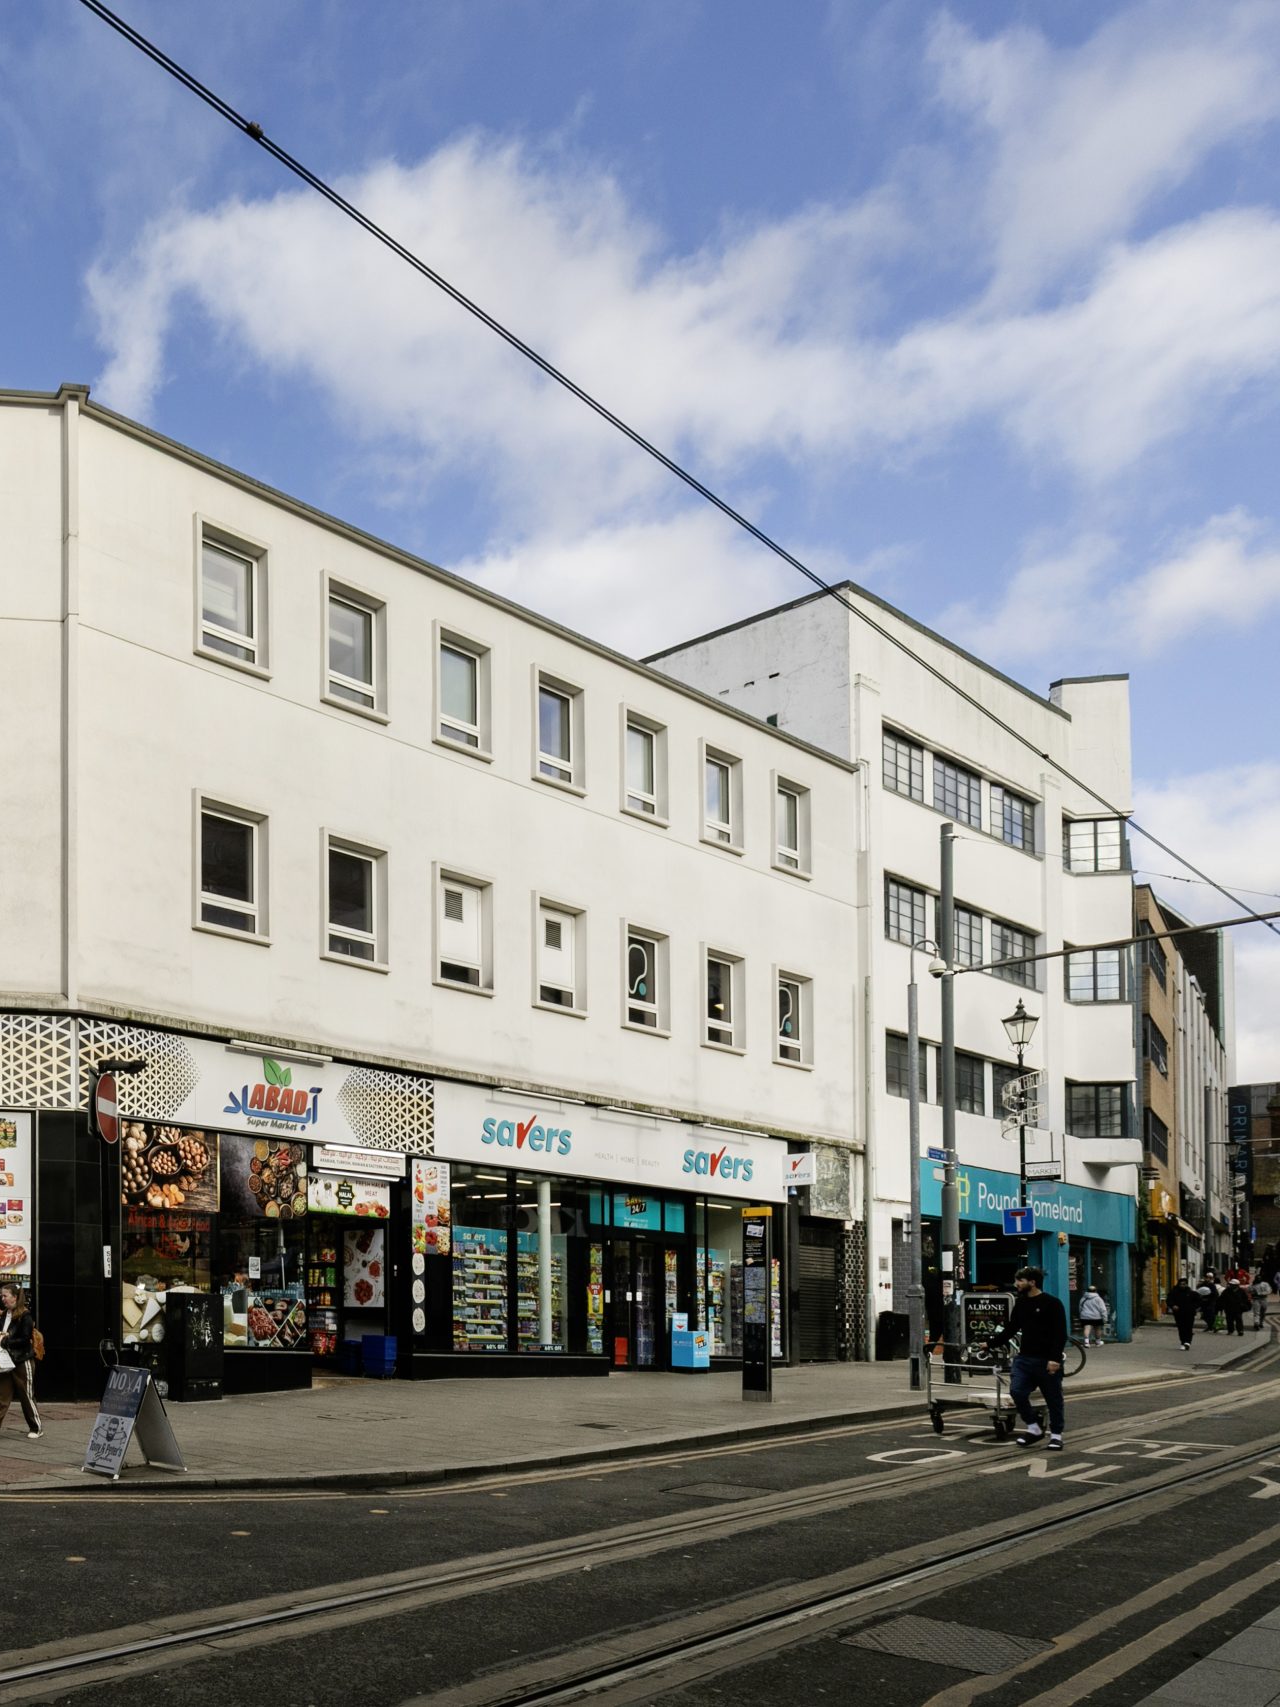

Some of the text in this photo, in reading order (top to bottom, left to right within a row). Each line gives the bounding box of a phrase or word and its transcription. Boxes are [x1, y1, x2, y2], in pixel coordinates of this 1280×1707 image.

[248, 1083, 308, 1115] ABAD
[247, 1116, 298, 1131] Super Market
[481, 1115, 573, 1155] savers
[1232, 1105, 1248, 1175] PRIMAR
[594, 1152, 660, 1167] HEALTH HOME BEAUTY
[682, 1146, 754, 1182] savers
[978, 1183, 1019, 1210] Pound
[969, 1320, 996, 1330] CAS
